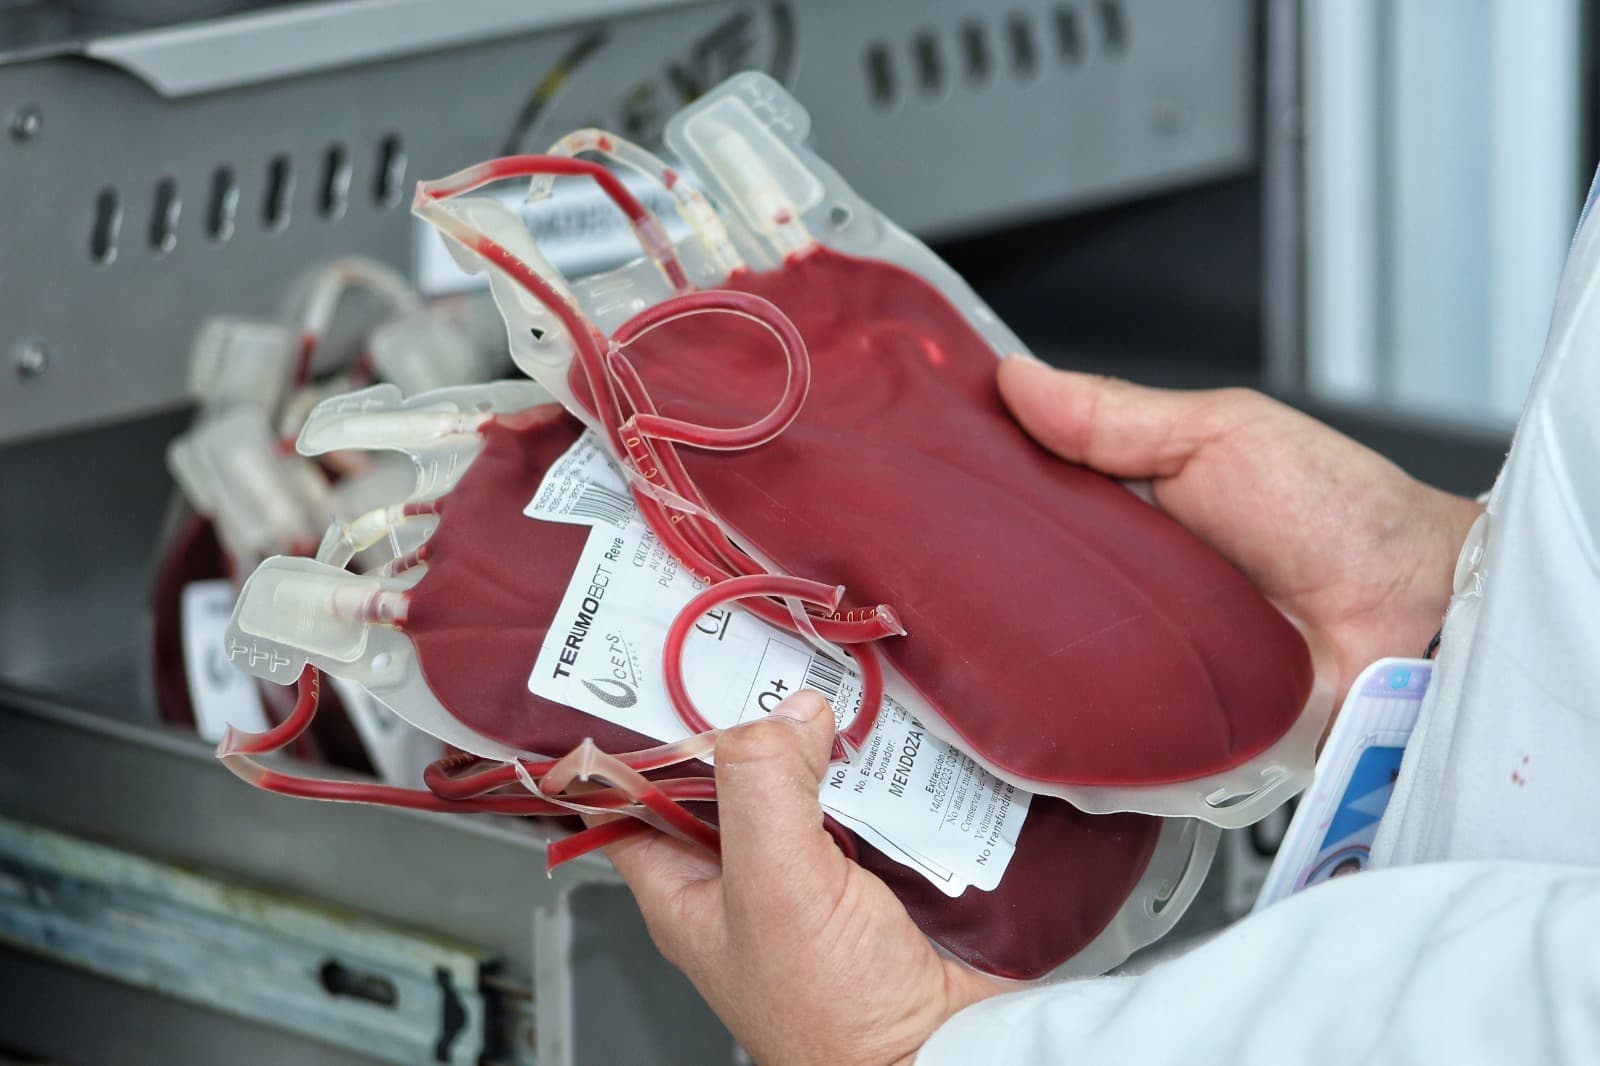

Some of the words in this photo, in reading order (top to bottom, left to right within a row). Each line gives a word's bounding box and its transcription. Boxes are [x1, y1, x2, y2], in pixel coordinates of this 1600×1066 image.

[829, 767, 848, 789] No.
[873, 738, 897, 781] Donador:
[888, 729, 925, 799] MENDOZA
[976, 848, 991, 866] No
[986, 795, 1012, 847] transfundir
